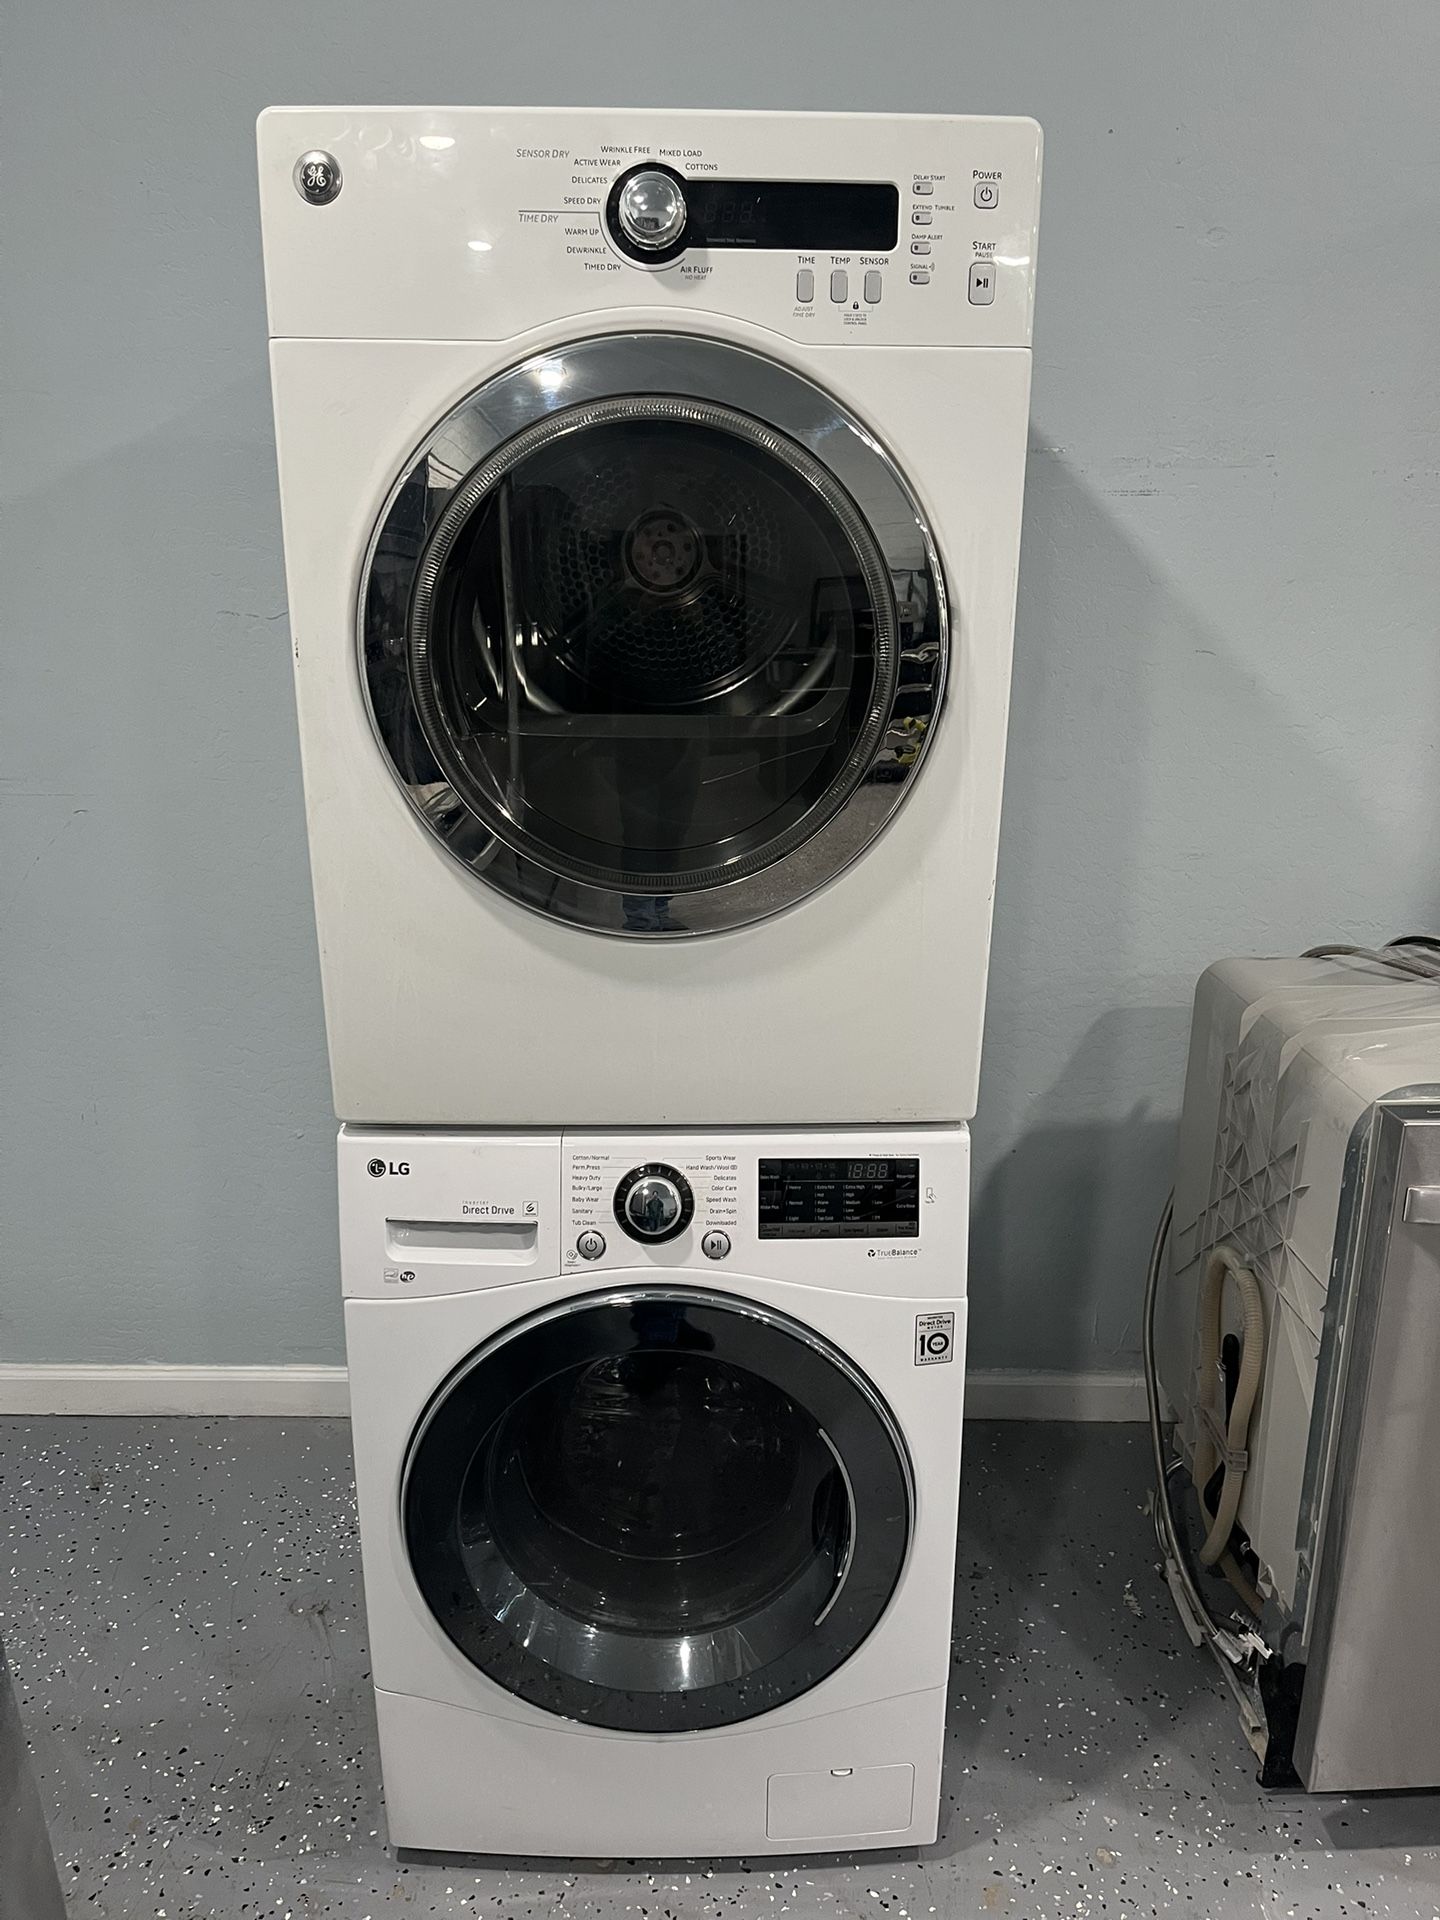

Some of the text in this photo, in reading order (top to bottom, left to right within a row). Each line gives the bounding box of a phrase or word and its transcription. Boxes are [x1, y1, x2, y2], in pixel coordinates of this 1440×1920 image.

[600, 145, 651, 154] WRINKLE FREE
[659, 149, 703, 157] MIXED LOAD
[516, 149, 570, 160] SENSOR DRY
[574, 159, 621, 167] ACTIVE WEAR
[685, 163, 718, 171] COTTONS
[972, 169, 1003, 180] POWER
[571, 176, 608, 184] DELICATES
[563, 197, 601, 205] SPEED DRY
[934, 204, 955, 212] TUMBLE
[518, 214, 559, 224] TIME DRY
[564, 228, 600, 236] WARM UP
[927, 233, 943, 241] ALERT
[566, 246, 607, 255] DEWRINKLE
[972, 241, 997, 251] START
[797, 256, 816, 264] TIME
[830, 256, 851, 265] TEMP
[859, 256, 889, 265] SENSOR
[584, 263, 621, 271] TIMED DRY
[680, 265, 713, 274] AIR FLUFF
[389, 1162, 410, 1175] LG
[462, 1205, 490, 1214] Direct
[491, 1205, 515, 1214] Drive
[919, 1332, 950, 1356] 10
